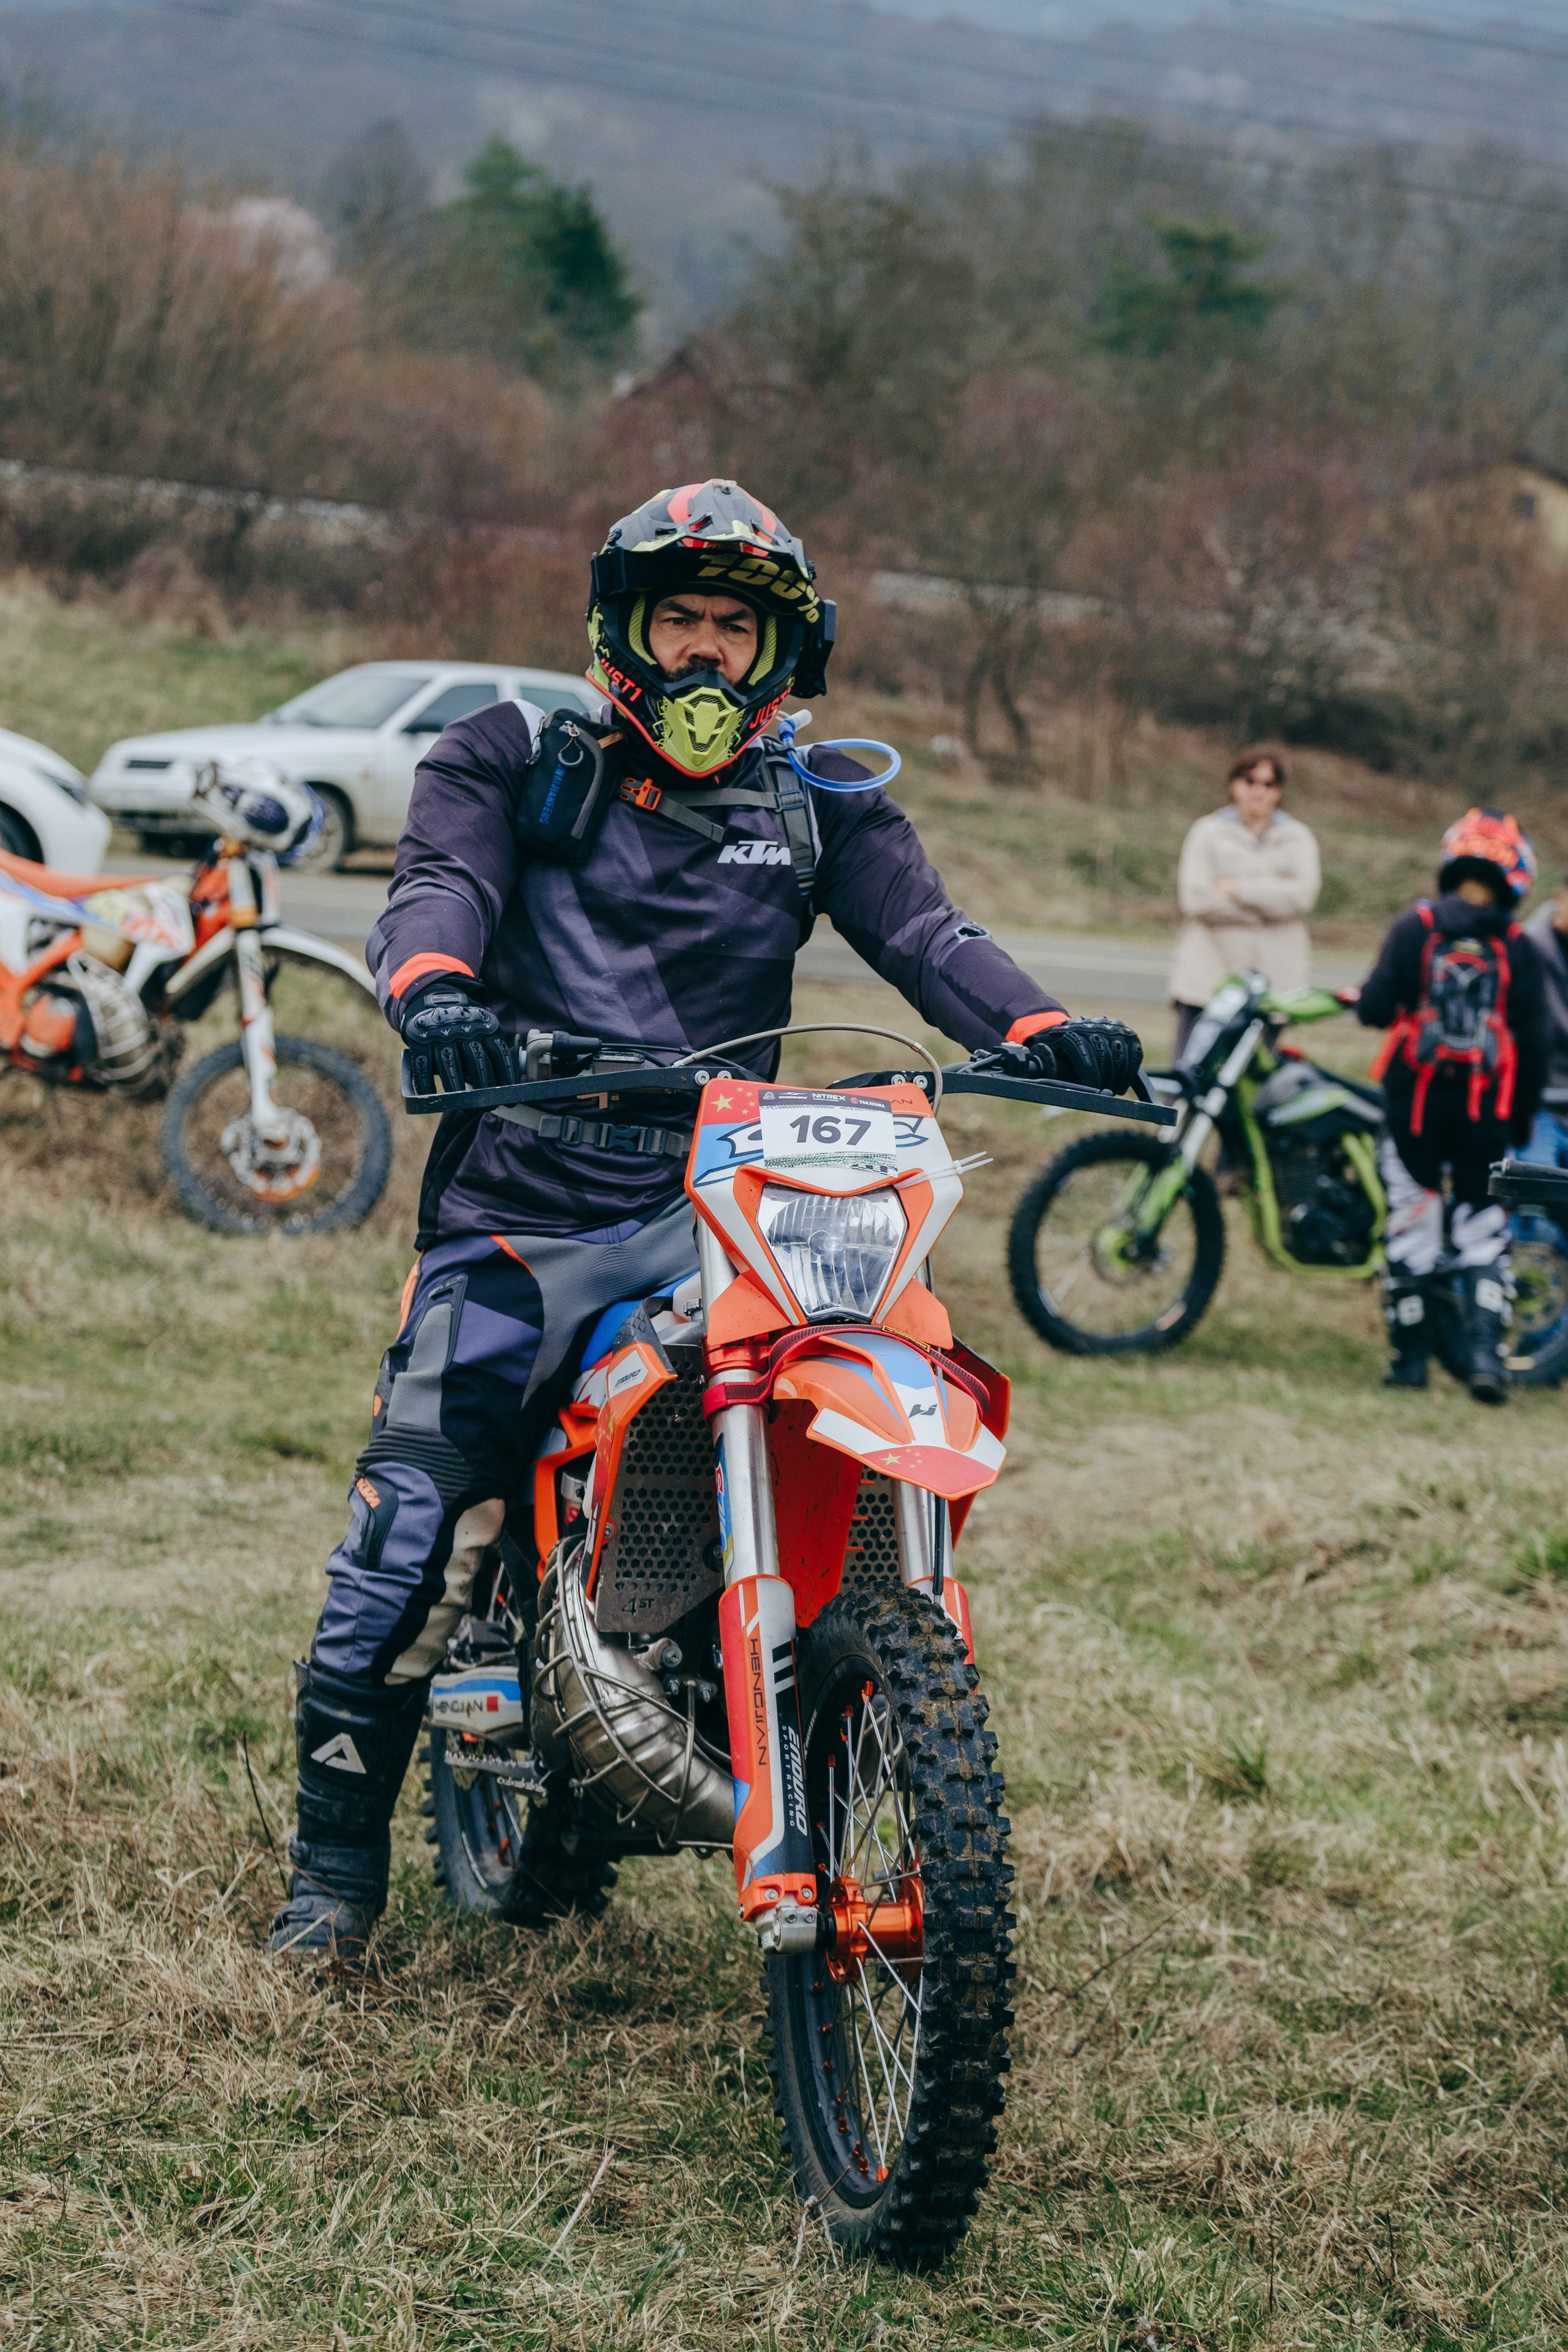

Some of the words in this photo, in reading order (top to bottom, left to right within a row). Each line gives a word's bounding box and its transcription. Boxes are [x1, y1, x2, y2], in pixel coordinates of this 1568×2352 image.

[697, 554, 821, 624] 100%
[717, 840, 791, 865] KTM
[812, 1093, 846, 1101] NITREX
[790, 1115, 872, 1146] 167
[750, 1638, 767, 1765] HENGJIAN
[788, 1725, 808, 1836] ENDURO
